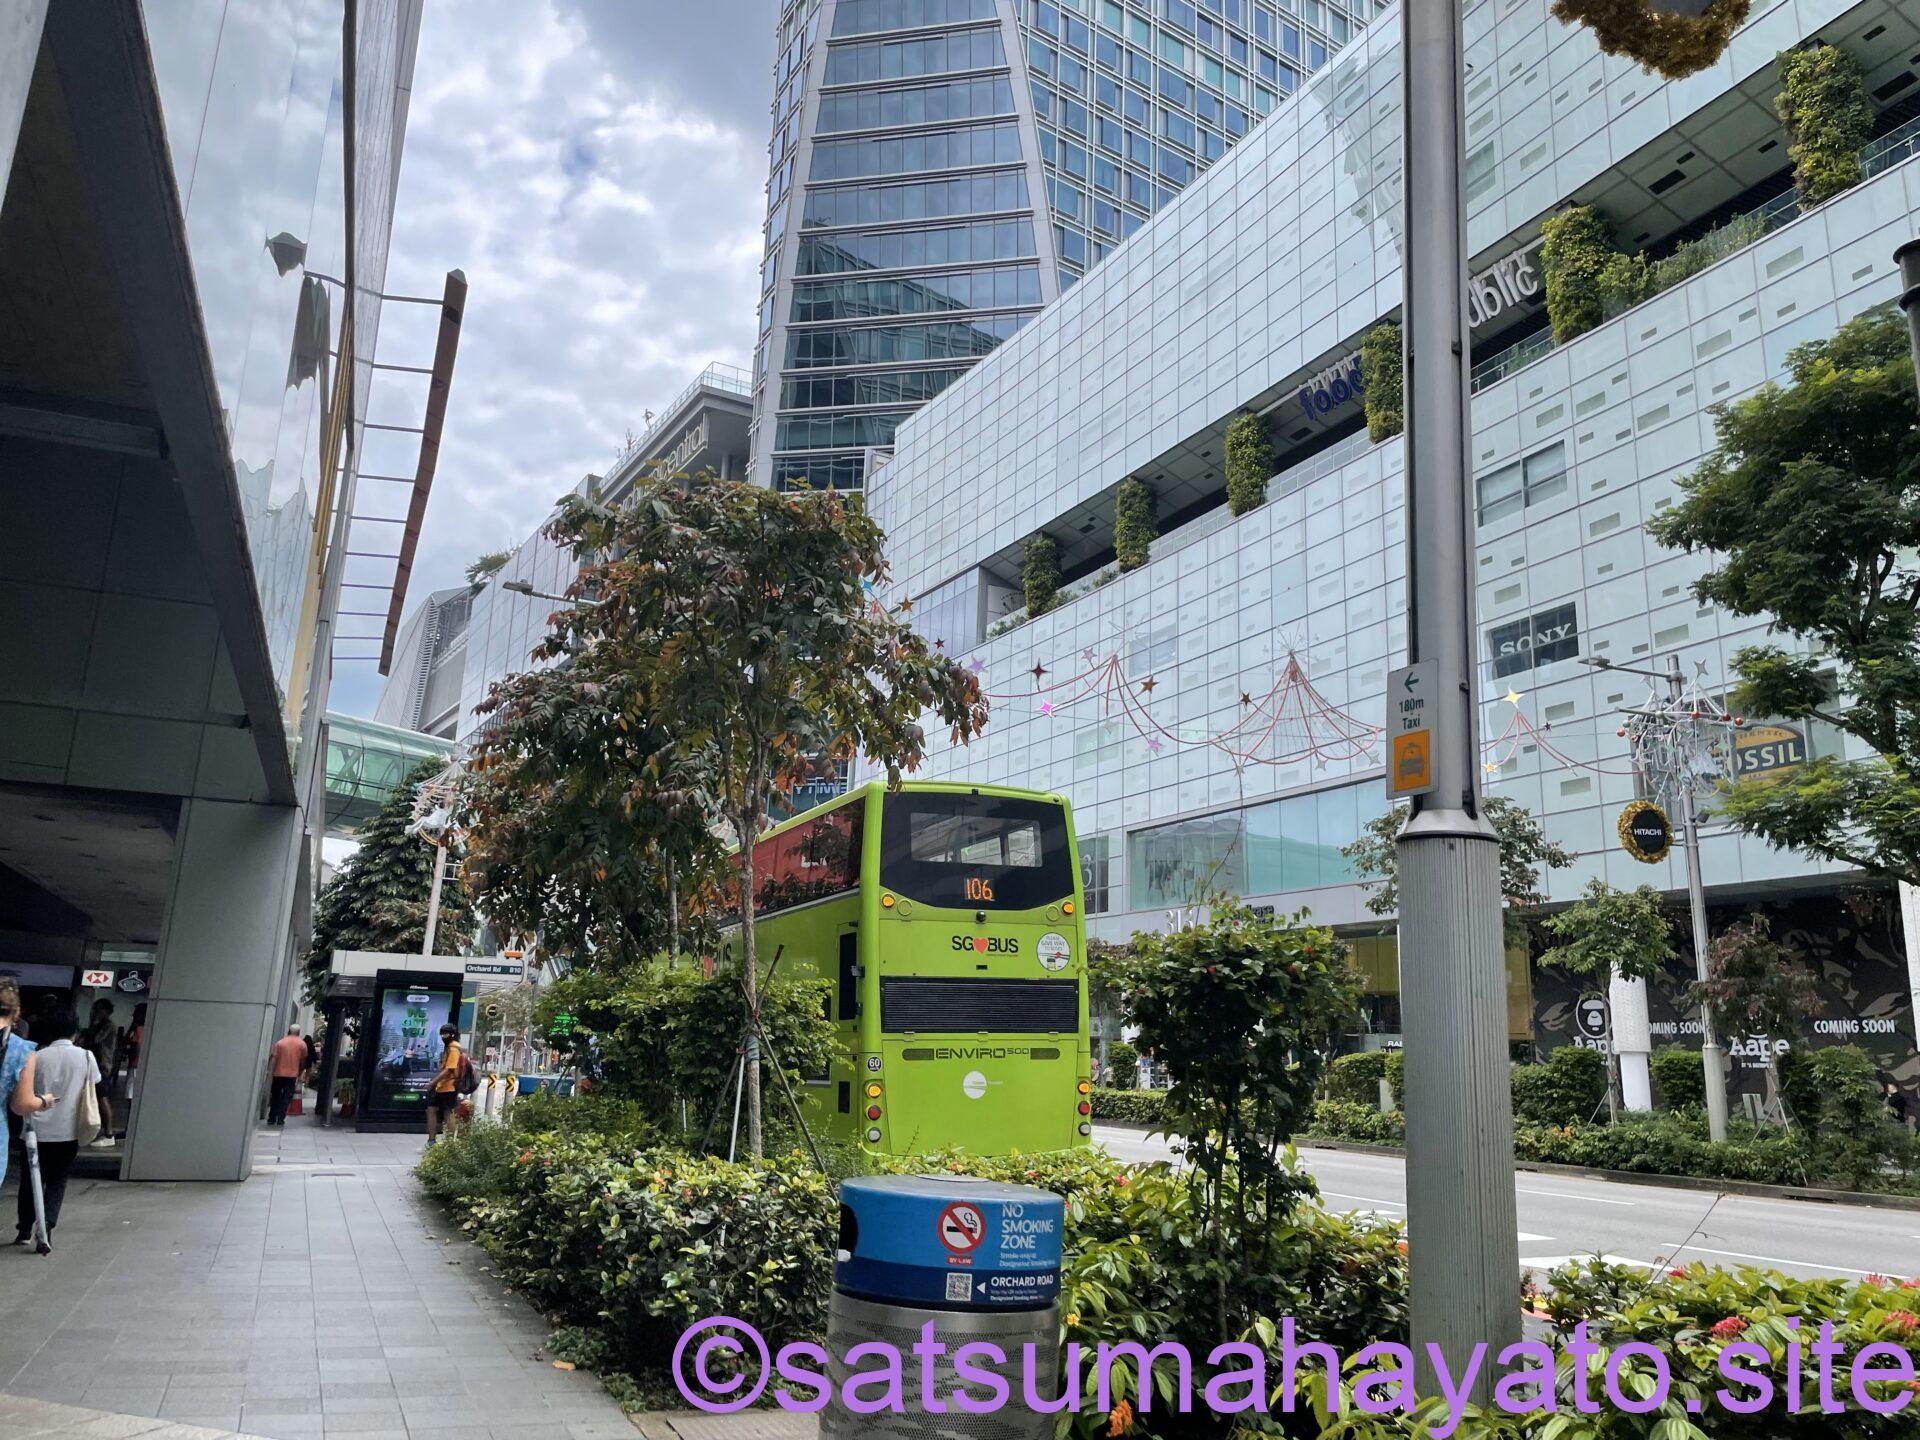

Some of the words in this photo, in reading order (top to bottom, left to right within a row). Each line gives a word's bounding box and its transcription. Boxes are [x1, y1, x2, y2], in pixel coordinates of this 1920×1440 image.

[1500, 622, 1572, 657] SONY
[1399, 698, 1424, 714] 180m
[1402, 714, 1421, 731] Taxi
[1633, 828, 1662, 836] HITACHI
[966, 877, 993, 900] 106
[466, 965, 492, 973] Orchard
[1649, 1021, 1678, 1035] OMING
[1814, 1020, 1859, 1034] COMING
[1862, 1019, 1896, 1034] SOON
[869, 1058, 881, 1068] 60
[1002, 1204, 1024, 1218] NO
[1001, 1219, 1054, 1234] SMOKING
[1000, 1234, 1037, 1249] ZONE
[991, 1276, 1035, 1287] ORCHARD
[1036, 1274, 1054, 1286] ROAD
